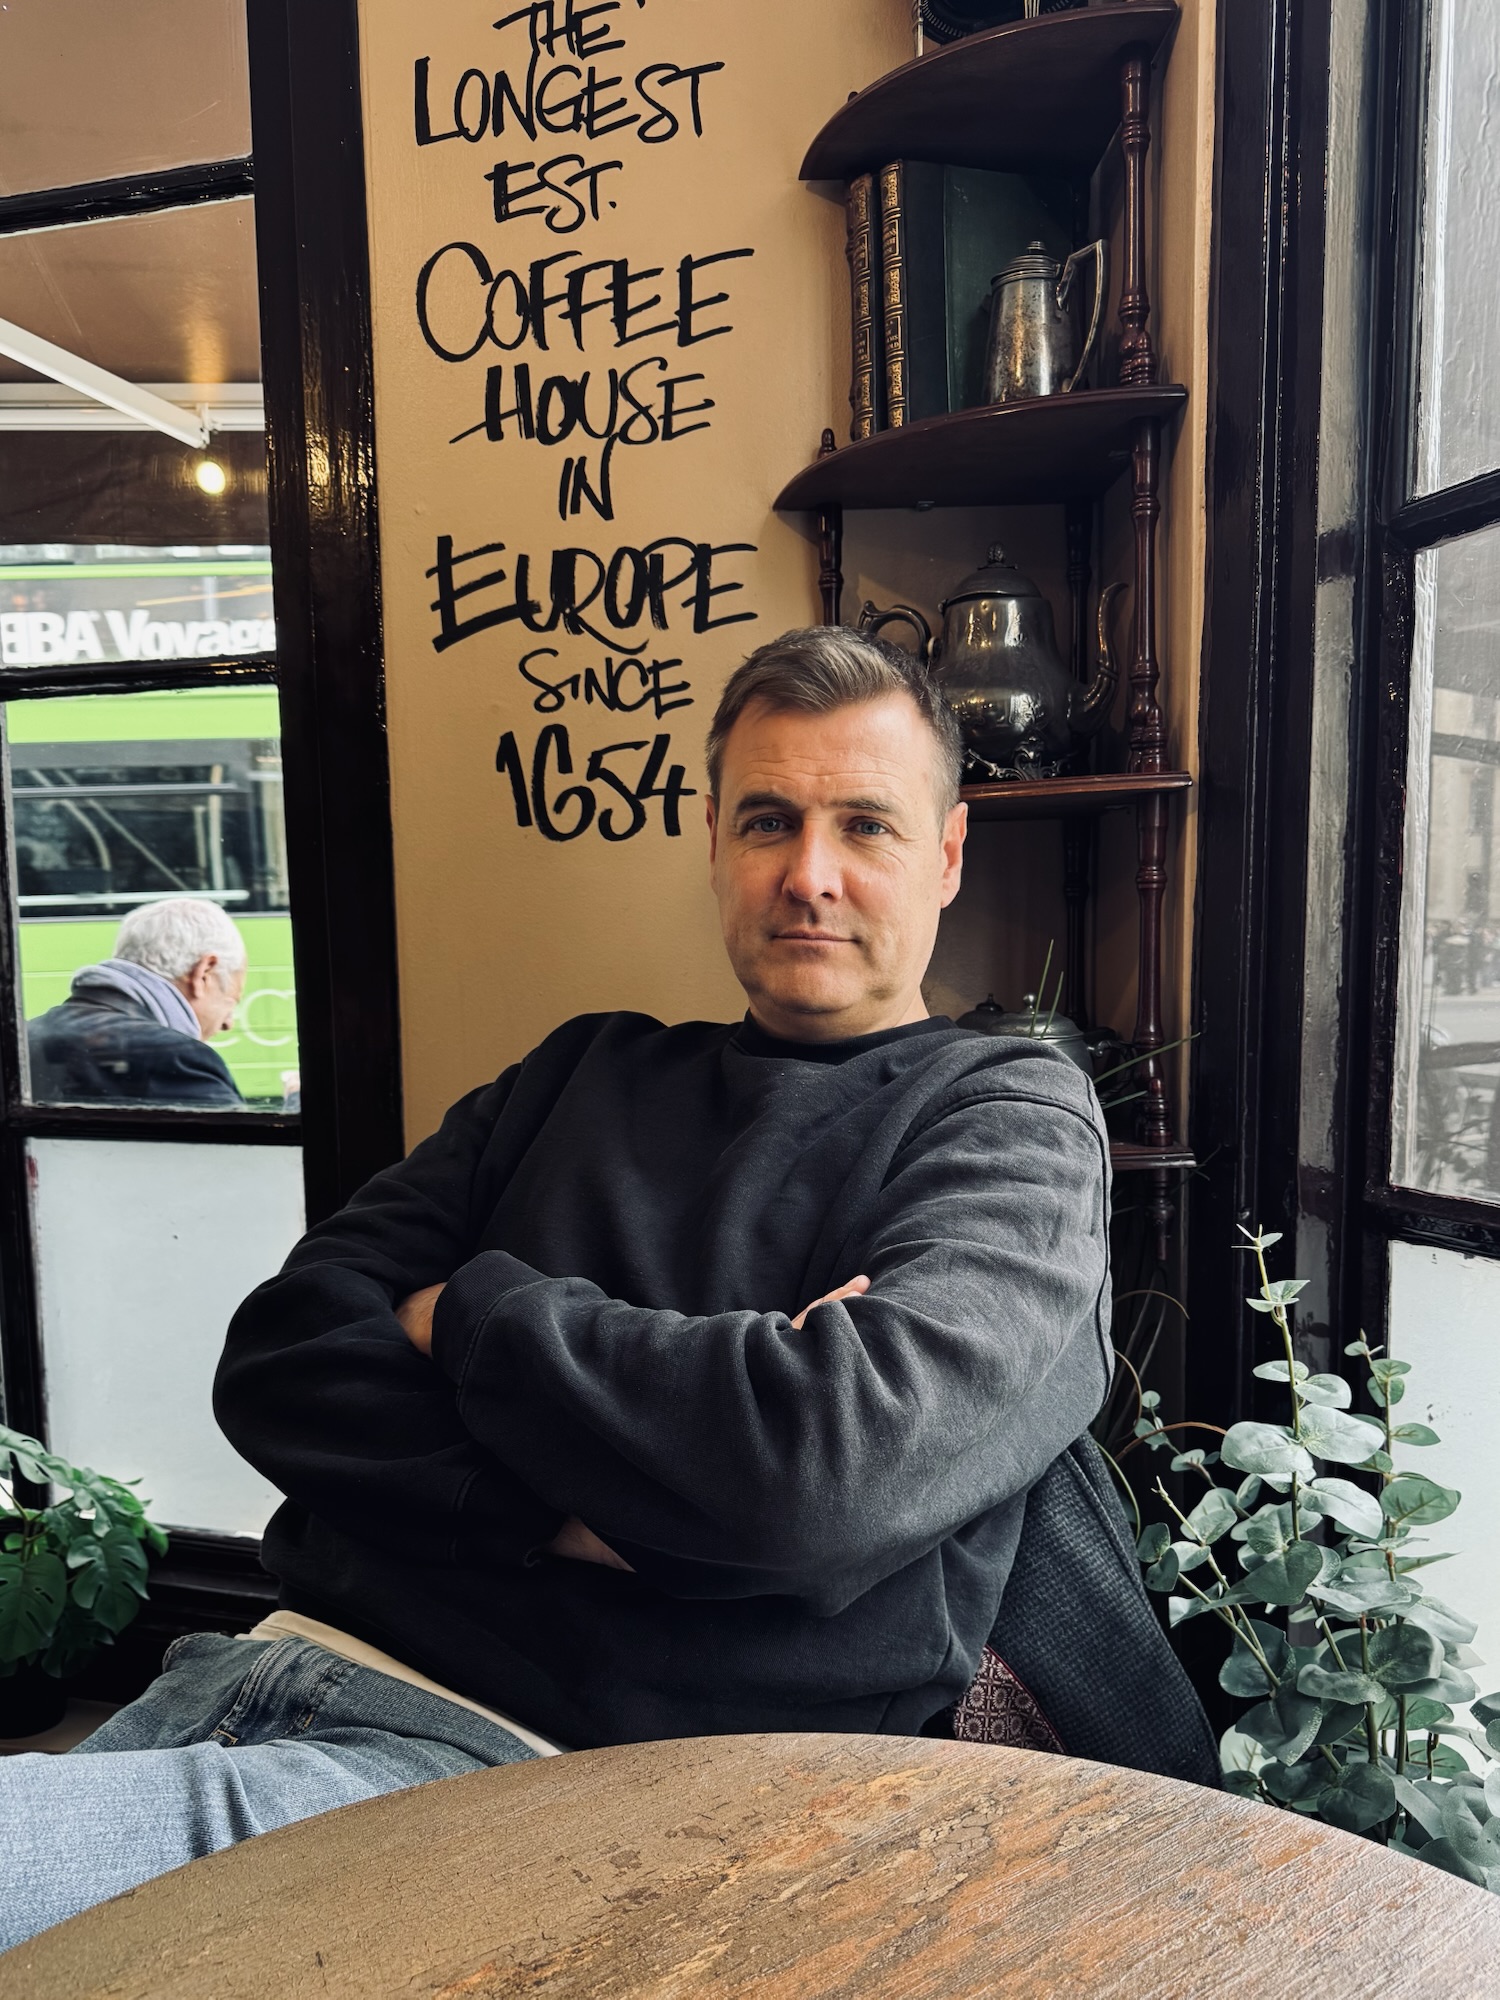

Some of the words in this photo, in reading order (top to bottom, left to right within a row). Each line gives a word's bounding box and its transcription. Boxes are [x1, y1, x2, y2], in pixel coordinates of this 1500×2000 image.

[492, 0, 626, 60] THE
[415, 56, 725, 146] LONGEST
[484, 154, 623, 233] EST.
[416, 242, 755, 362] COFFEE
[449, 357, 715, 445] HOUSE
[559, 438, 614, 521] IN
[426, 535, 758, 655] EUROPE
[519, 648, 694, 720] SINCE
[496, 724, 697, 842] 1654
